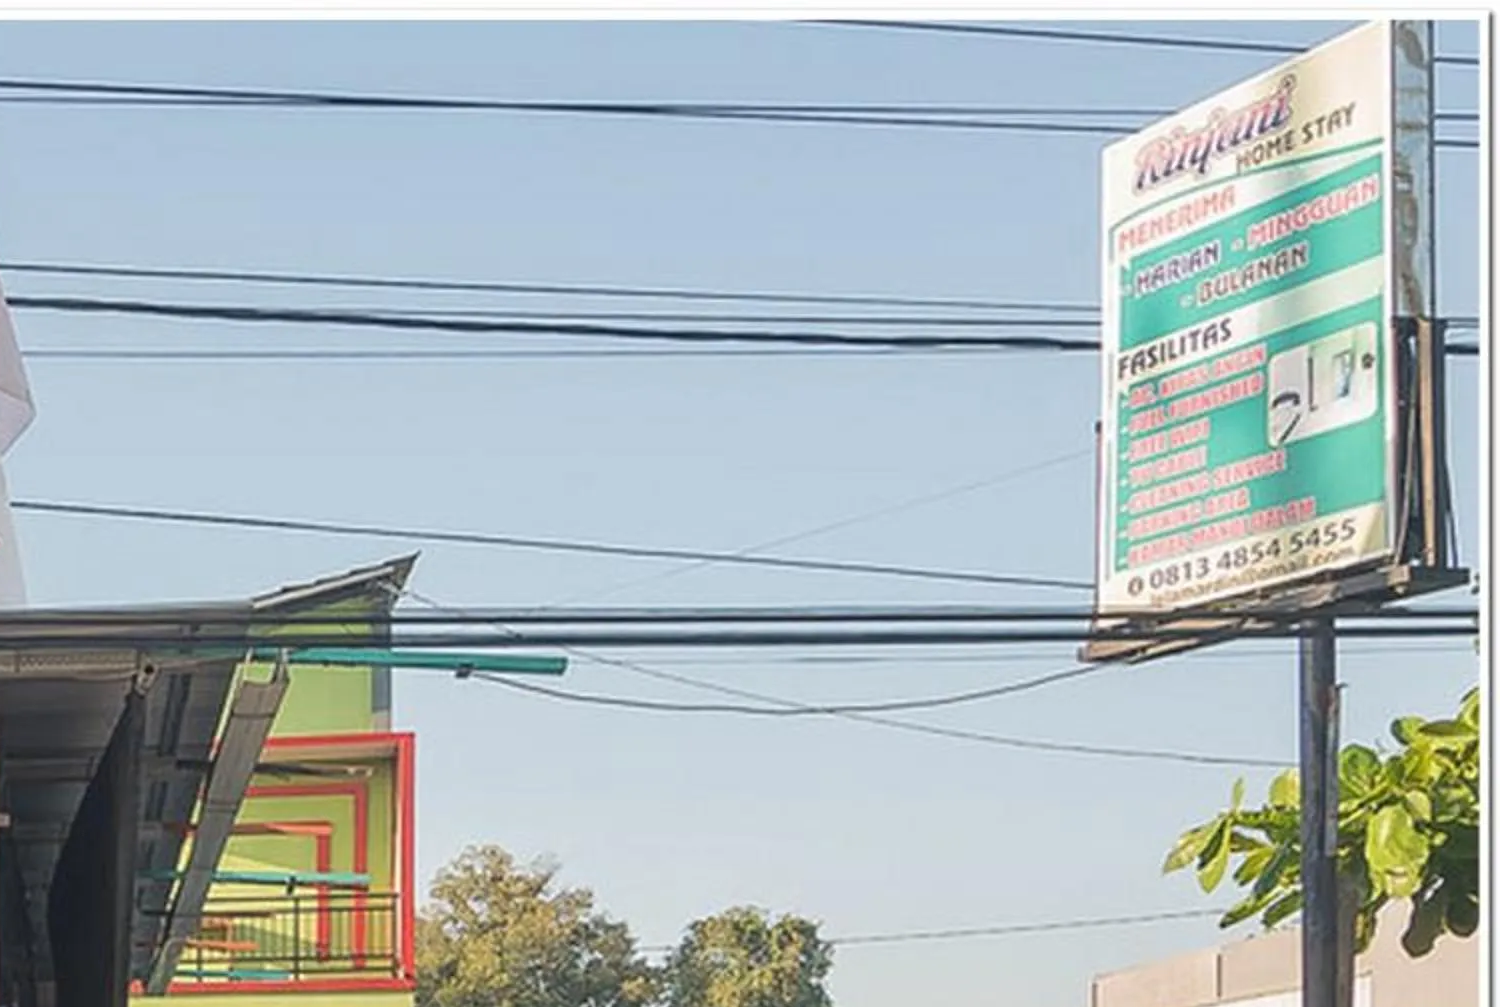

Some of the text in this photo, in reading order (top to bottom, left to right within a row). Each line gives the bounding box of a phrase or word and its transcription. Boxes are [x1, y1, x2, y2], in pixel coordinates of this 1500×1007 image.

[1133, 72, 1297, 196] Rinjani
[1236, 102, 1356, 172] HOME STAY
[1118, 185, 1236, 251] MENERIMA
[1248, 179, 1378, 246] MINGGUAN
[1199, 244, 1308, 303] BULANAN
[1118, 318, 1233, 380] FASILITAS
[1150, 519, 1357, 588] 0813 4854 5455
